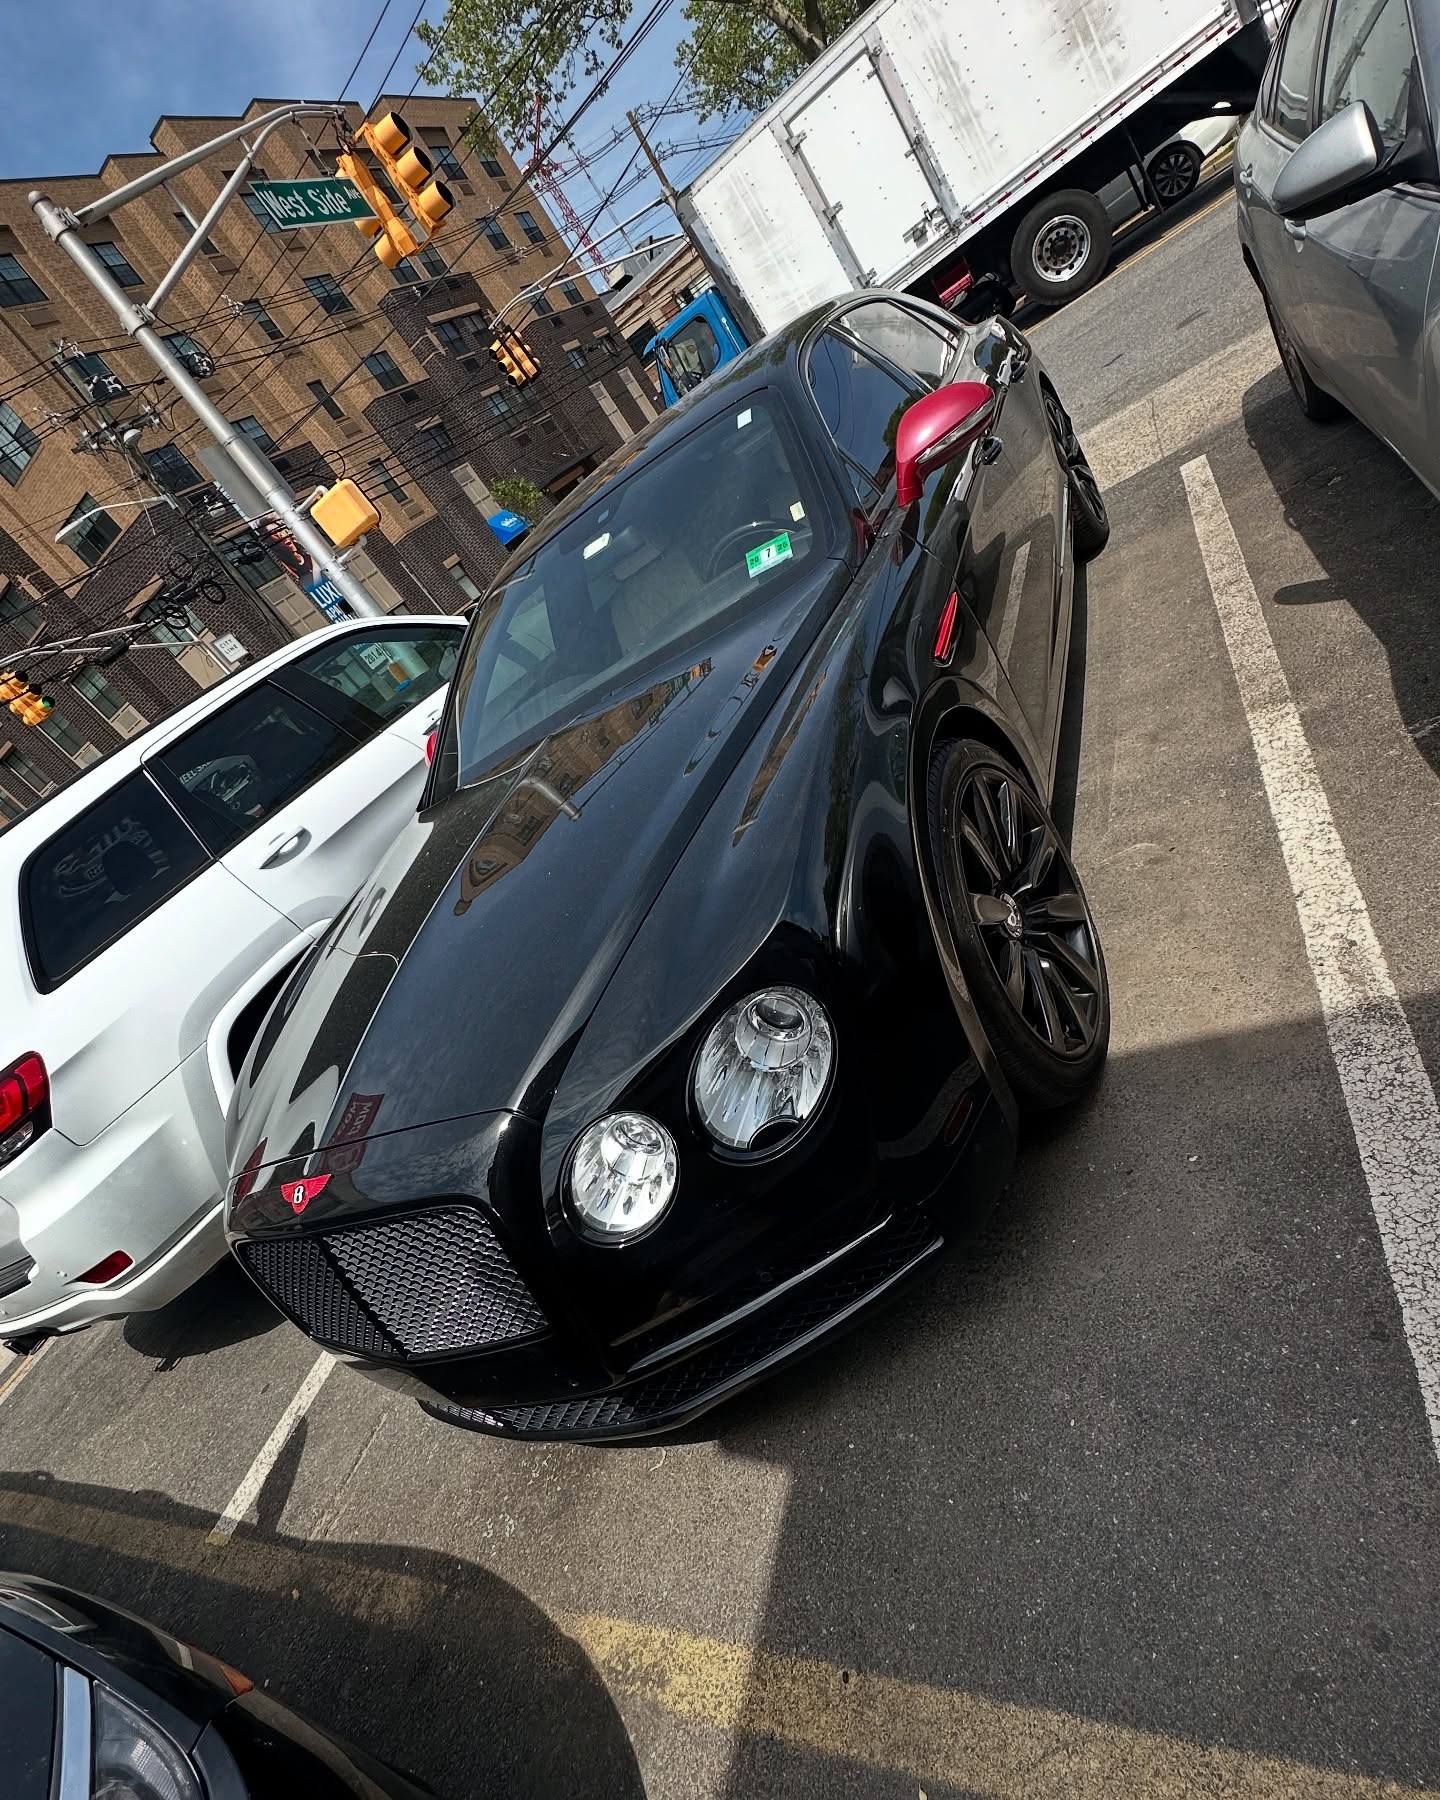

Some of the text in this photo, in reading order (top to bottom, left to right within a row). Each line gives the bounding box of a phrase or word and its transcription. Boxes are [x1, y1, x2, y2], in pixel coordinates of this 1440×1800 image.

[259, 185, 362, 218] West Side Ave
[765, 547, 771, 558] 7
[219, 639, 233, 649] CITY
[224, 643, 238, 655] LINE
